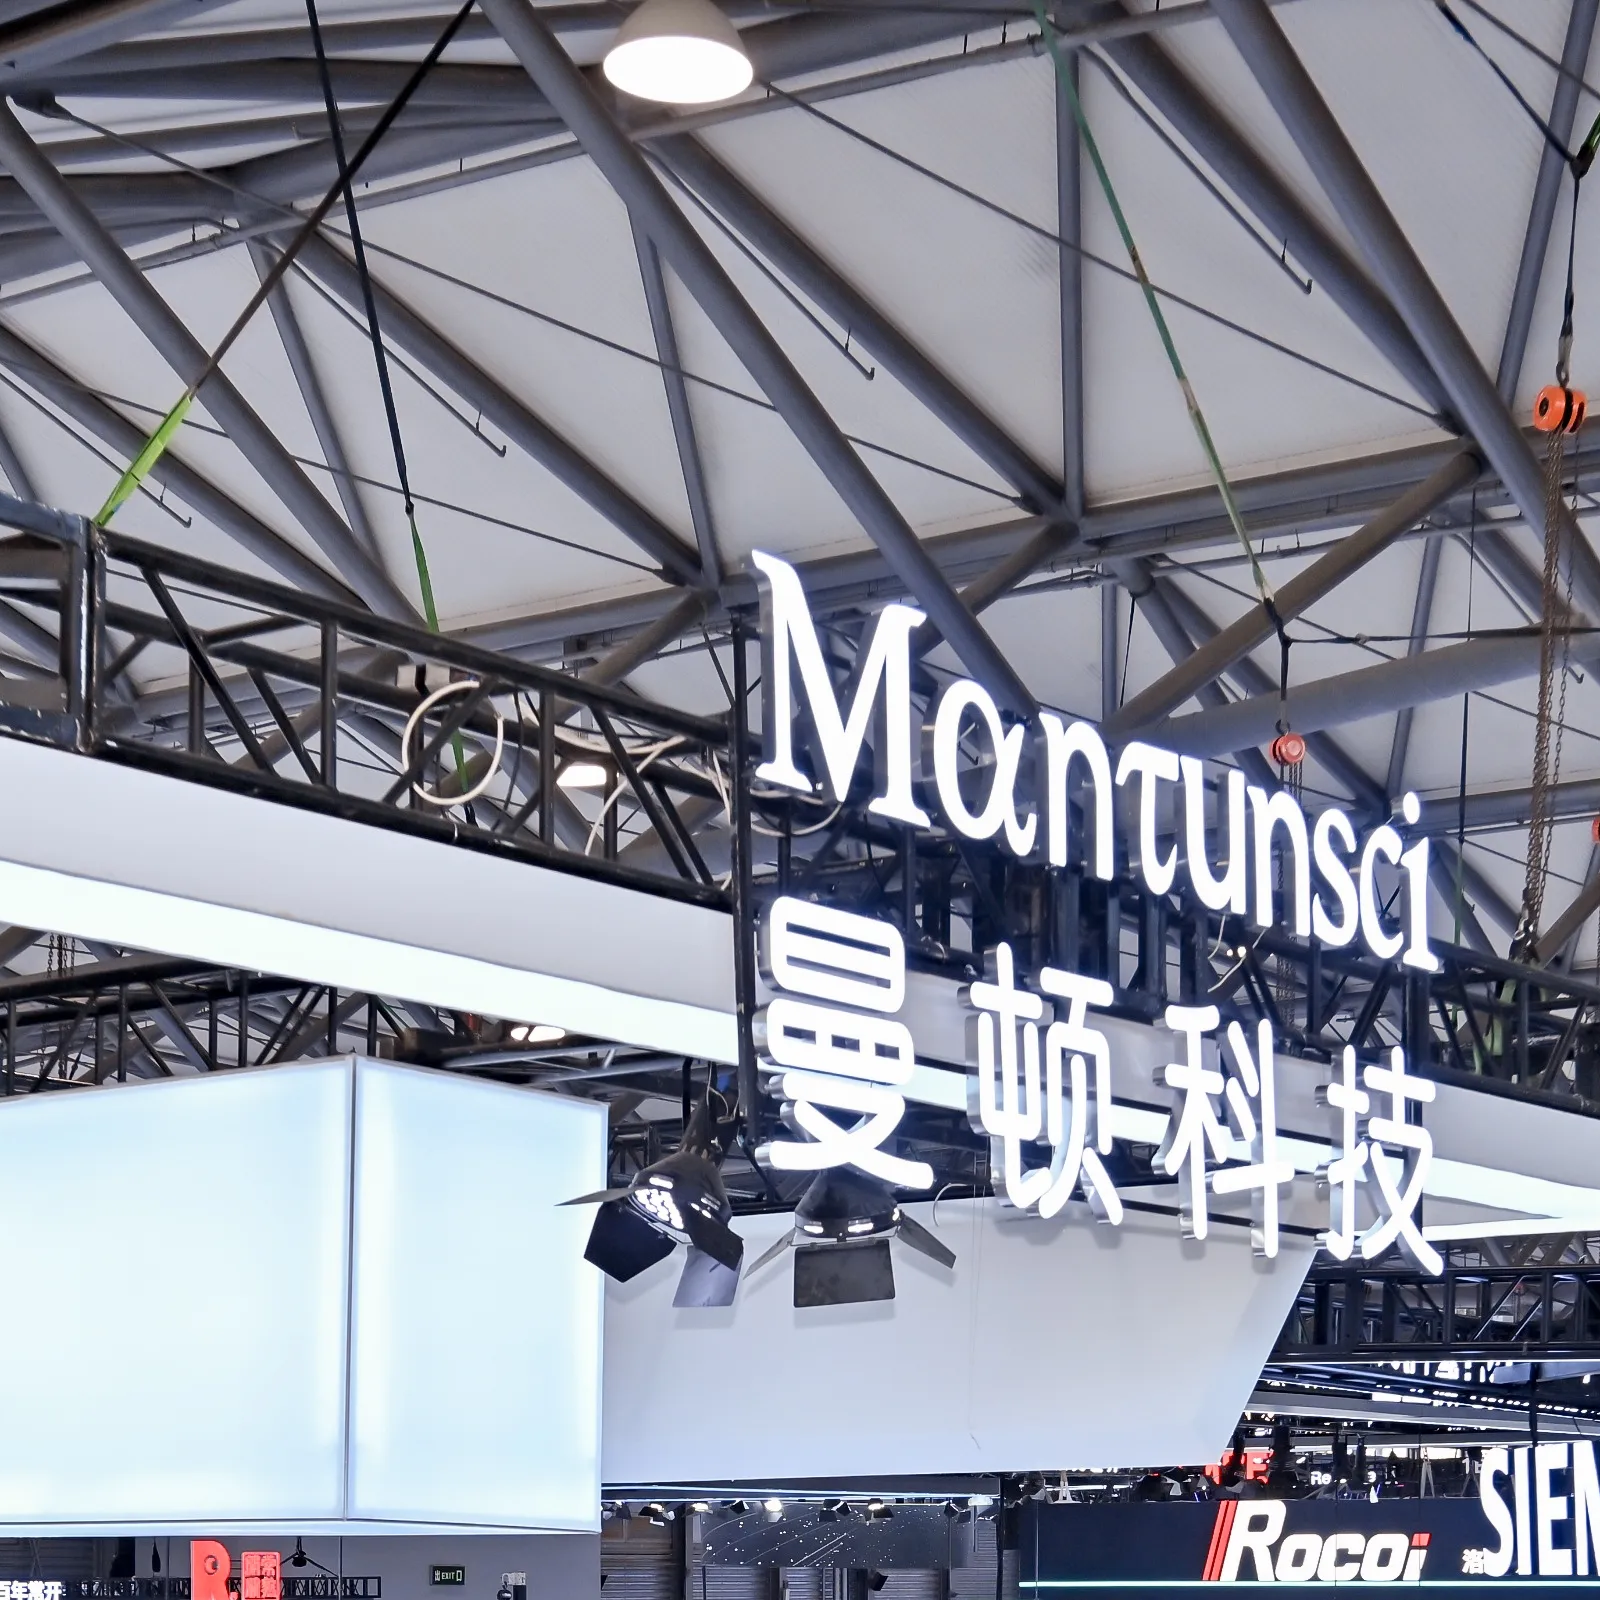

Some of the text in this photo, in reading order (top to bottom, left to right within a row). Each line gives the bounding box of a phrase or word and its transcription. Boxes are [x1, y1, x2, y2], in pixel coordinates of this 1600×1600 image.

[766, 895, 1446, 1276] 曼顿科技
[441, 1572, 455, 1582] EXIT
